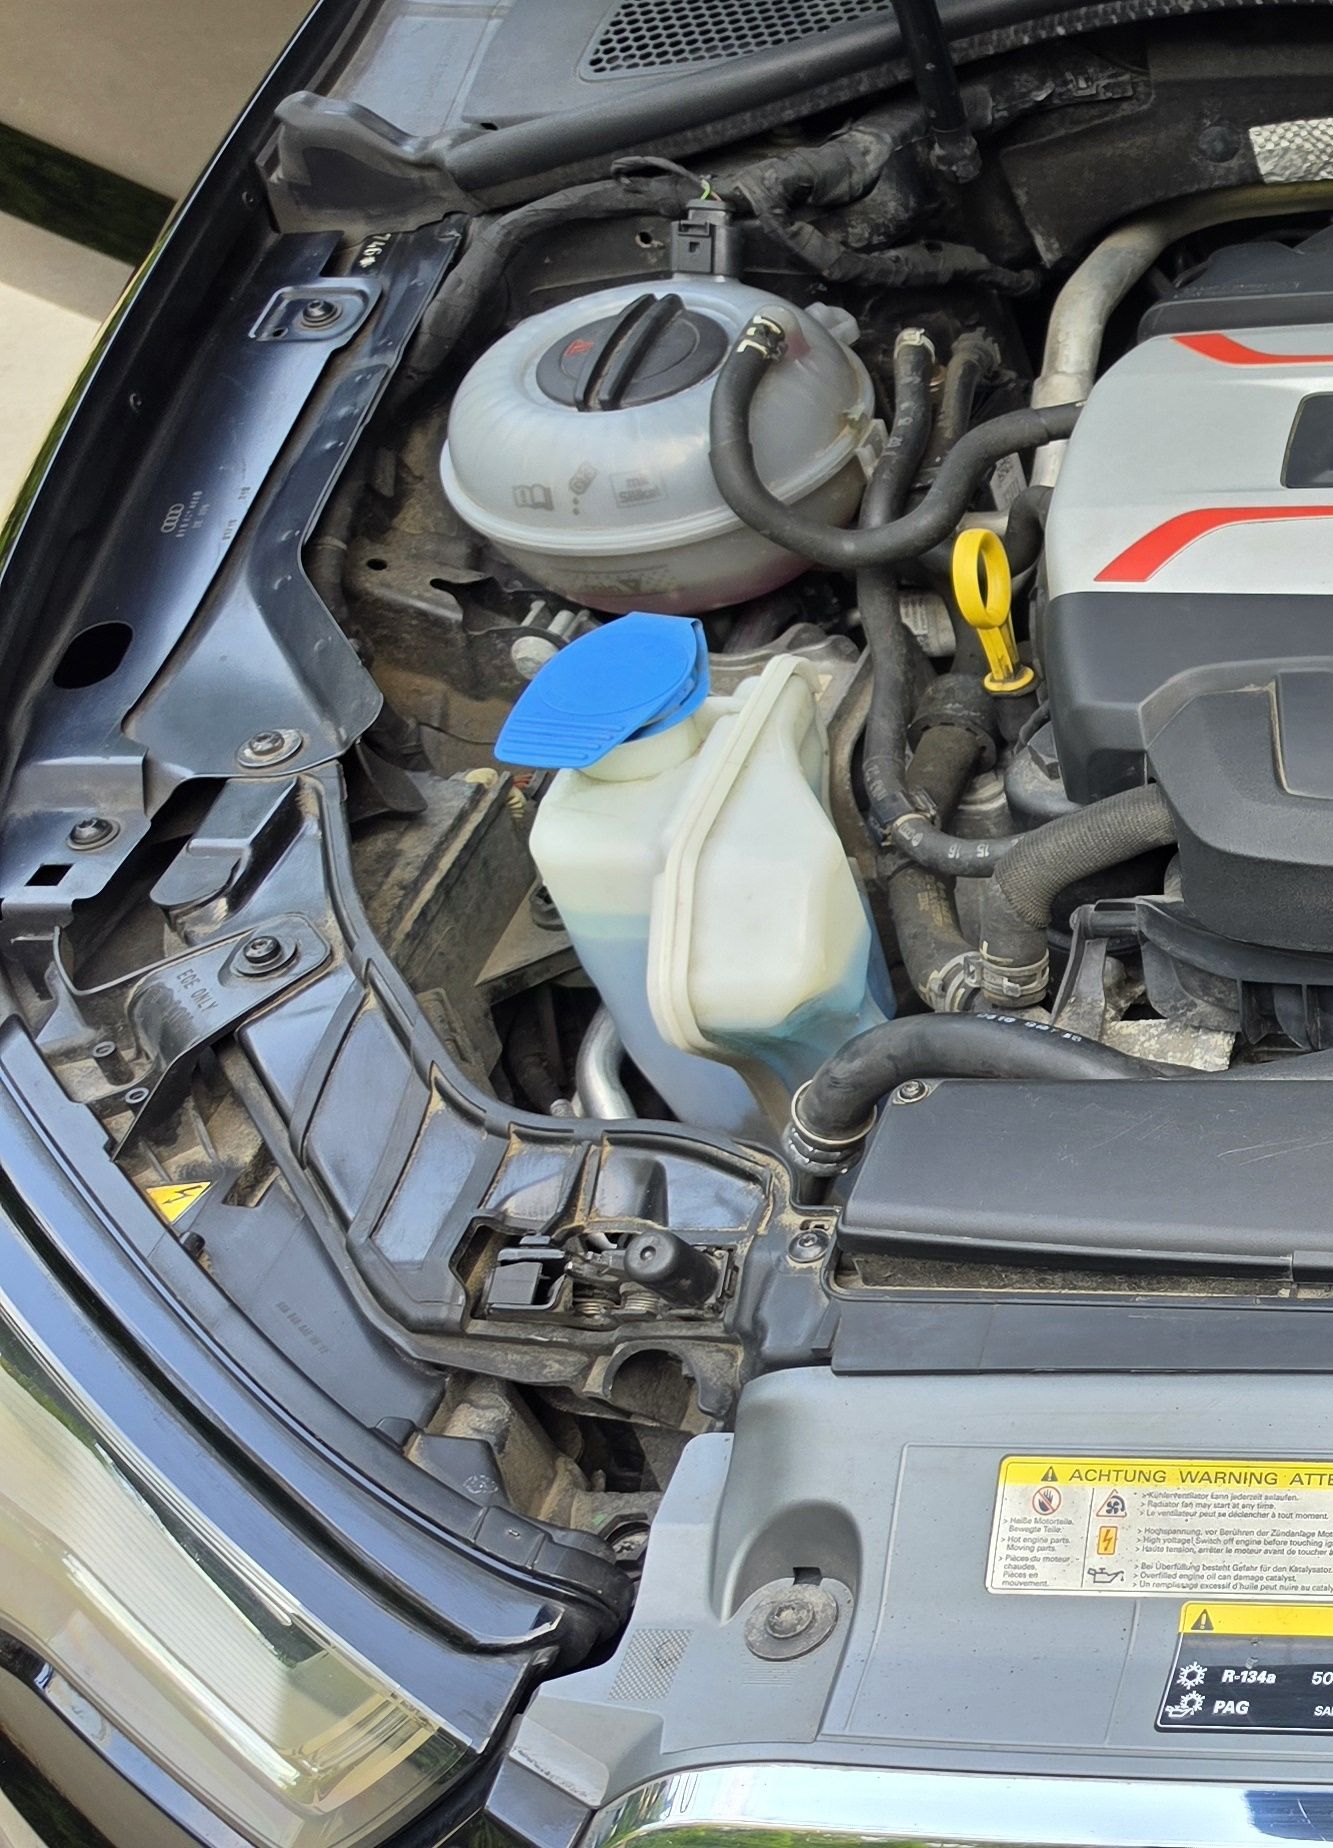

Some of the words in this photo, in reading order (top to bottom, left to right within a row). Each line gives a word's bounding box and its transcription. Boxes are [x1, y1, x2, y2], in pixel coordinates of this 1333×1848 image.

[1069, 1468, 1167, 1483] ACHTUNG
[1179, 1470, 1279, 1485] WARNING
[1147, 1500, 1180, 1508] Radiator
[1181, 1500, 1193, 1508] fan
[1195, 1502, 1211, 1510] may
[1213, 1501, 1230, 1509] start
[1241, 1502, 1255, 1510] any
[1146, 1509, 1156, 1517] Le
[1157, 1509, 1197, 1517] ventilateur
[1198, 1510, 1216, 1519] peut
[1219, 1528, 1255, 1536] Berühren
[1256, 1529, 1269, 1537] der
[1270, 1529, 1316, 1539] Zündanlage
[1023, 1536, 1048, 1545] engine
[1143, 1536, 1161, 1545] High
[1196, 1536, 1220, 1544] Switch
[1223, 1537, 1235, 1545] off
[1235, 1538, 1261, 1547] engine
[1289, 1539, 1324, 1548] touching
[1006, 1544, 1035, 1553] Moving
[1142, 1545, 1164, 1553] Haute
[1225, 1546, 1233, 1554] le
[1298, 1548, 1327, 1556] toucher
[1030, 1554, 1041, 1562] du
[1140, 1562, 1153, 1570] Bei
[1202, 1563, 1231, 1571] besteht
[1232, 1564, 1258, 1572] Gefahr
[1260, 1564, 1271, 1572] für
[1272, 1564, 1287, 1572] den
[1139, 1571, 1178, 1580] Overfilled
[1178, 1572, 1205, 1581] engine
[1206, 1572, 1216, 1580] oil
[1233, 1573, 1264, 1582] damage
[1139, 1580, 1151, 1588] Un
[1152, 1581, 1199, 1590] remplissage
[1199, 1582, 1232, 1590] excessif
[1259, 1583, 1278, 1591] peut
[1279, 1583, 1299, 1591] nuire
[1221, 1669, 1277, 1685] R-134a
[1212, 1700, 1250, 1715] PAG
